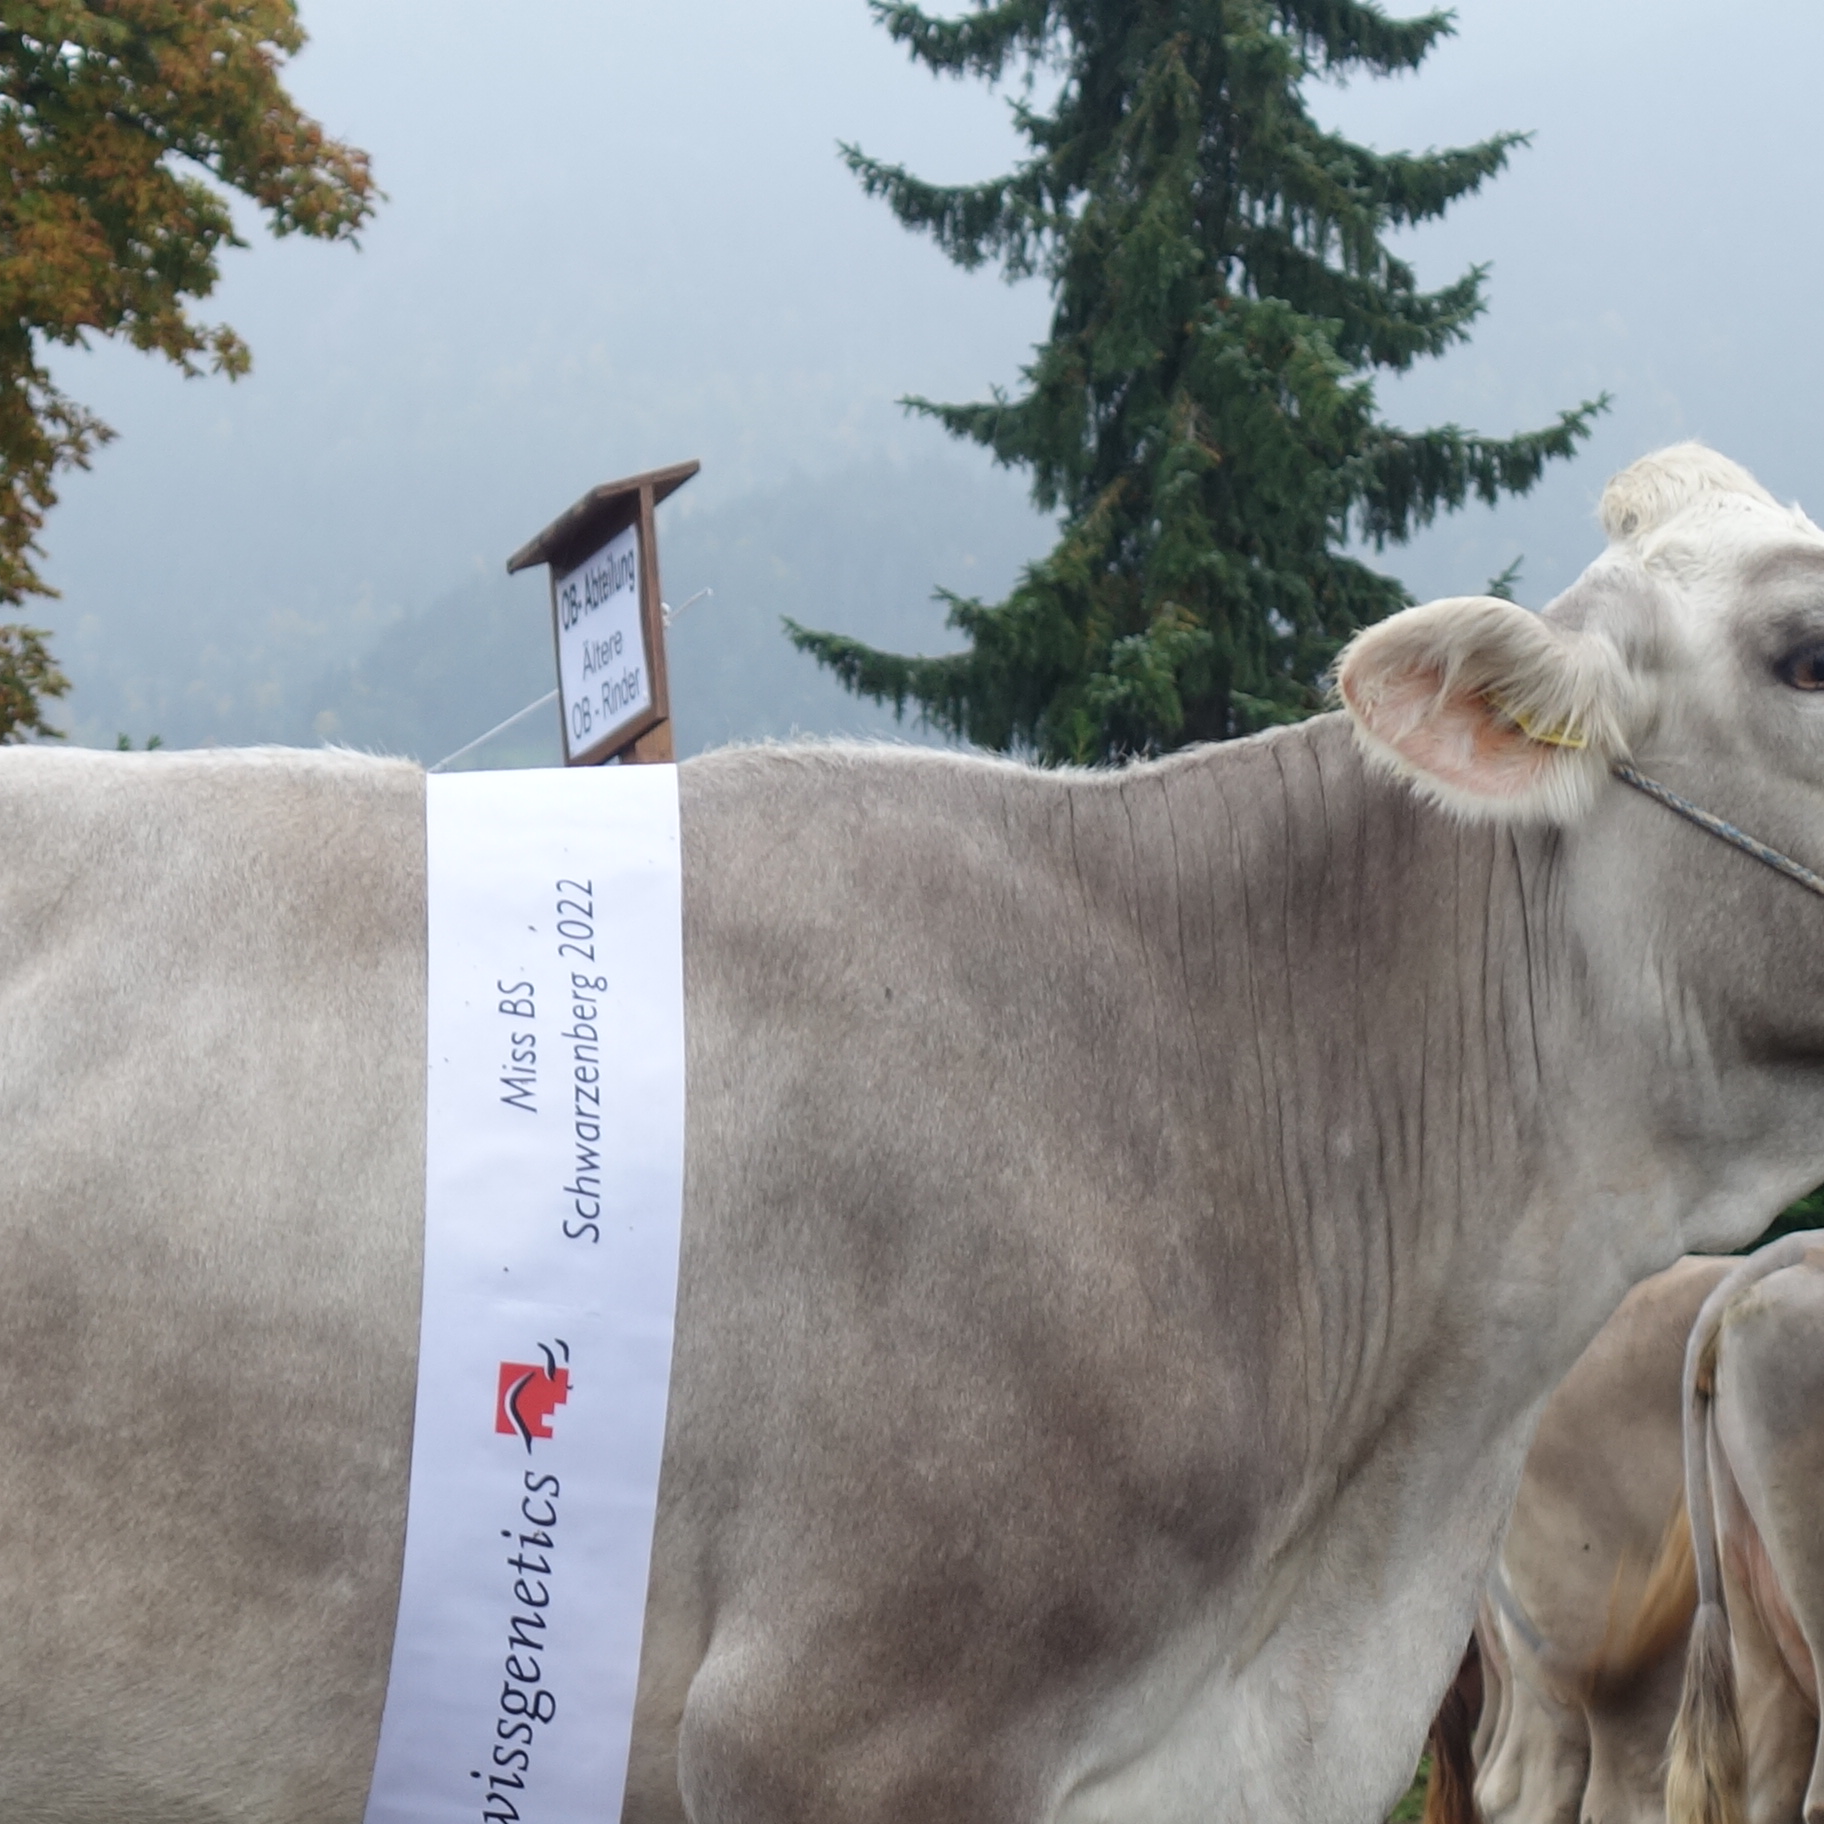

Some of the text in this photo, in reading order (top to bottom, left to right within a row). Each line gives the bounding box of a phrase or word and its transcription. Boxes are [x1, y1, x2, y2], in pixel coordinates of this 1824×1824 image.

[584, 549, 635, 616] Abteilung
[582, 630, 623, 680] Ältere
[571, 696, 592, 740] OB
[601, 665, 641, 722] Rinder
[496, 979, 539, 1114] Miss BS
[555, 878, 609, 1245] Schwarzenberg 2022
